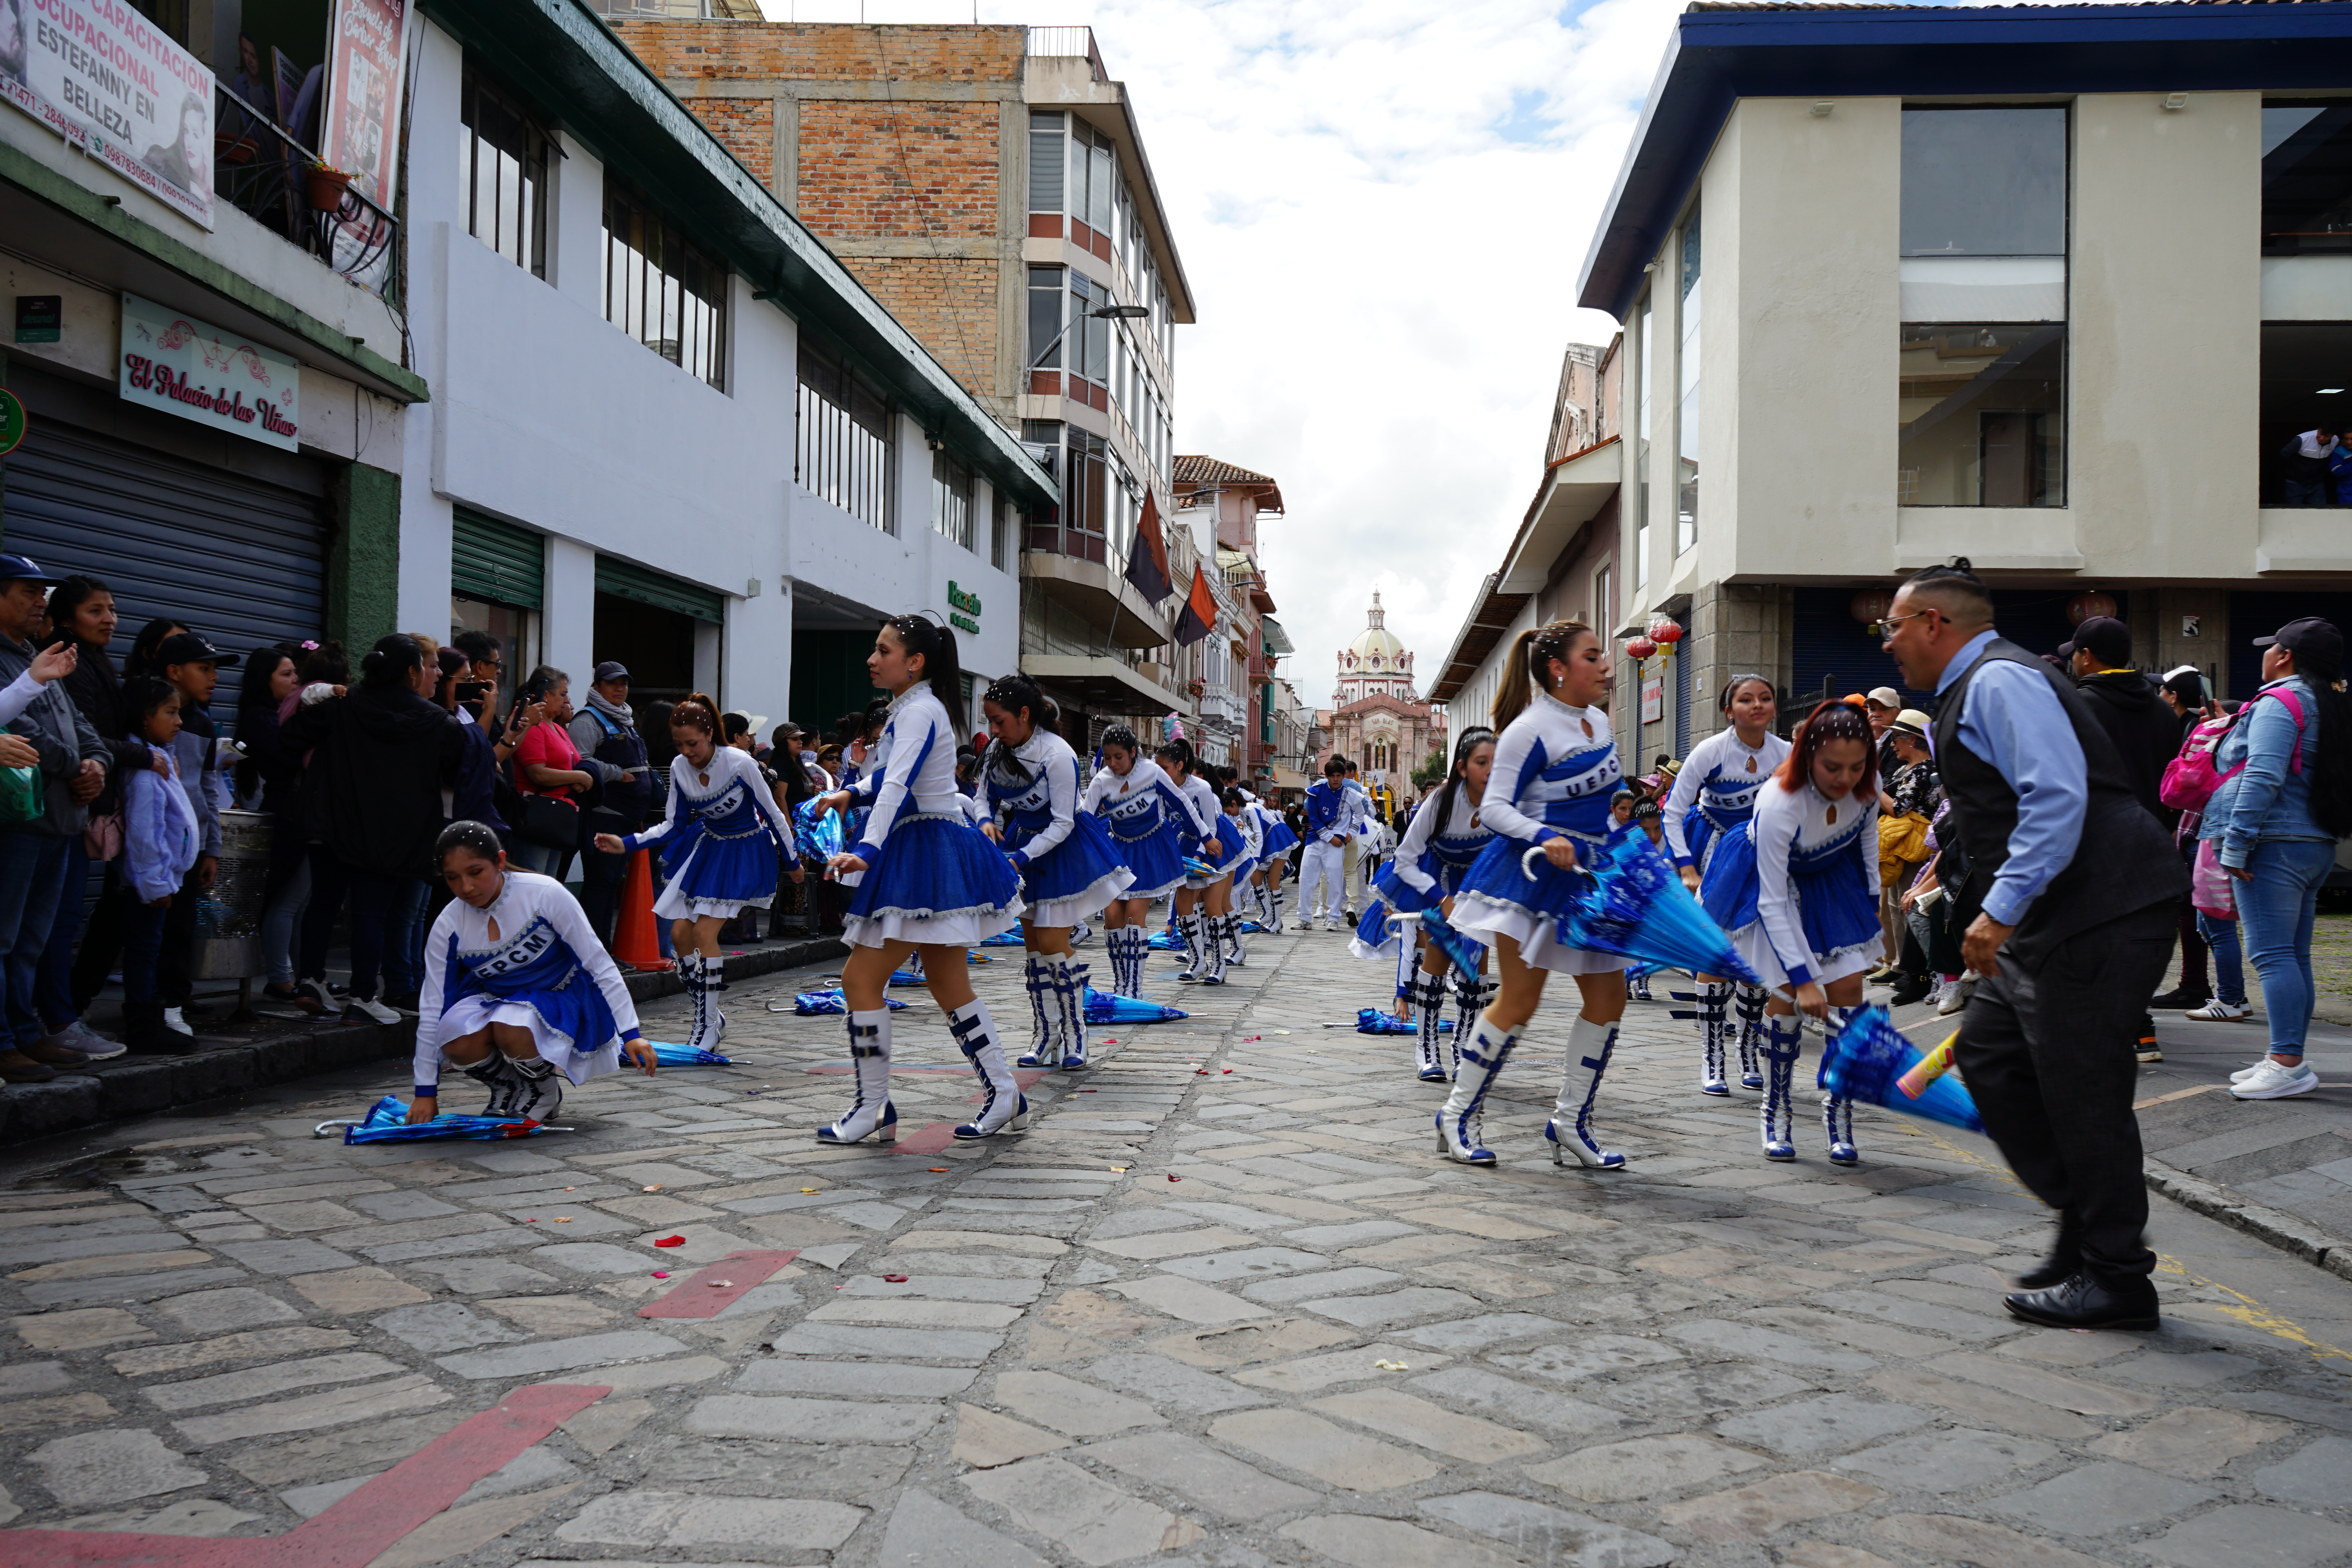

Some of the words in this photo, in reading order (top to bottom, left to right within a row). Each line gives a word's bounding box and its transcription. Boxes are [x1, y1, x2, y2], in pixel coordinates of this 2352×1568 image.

[343, 10, 375, 49] Barber
[375, 40, 398, 79] Shop
[352, 0, 383, 36] Escuela
[383, 18, 393, 43] de
[37, 18, 131, 105] ESTEFANNY
[136, 91, 154, 124] EN
[91, 0, 208, 100] CAPACITACIÓN
[64, 76, 132, 145] BELLEZA
[104, 144, 156, 187] 0987830684
[126, 354, 154, 390] El
[156, 365, 215, 409] Palacio
[216, 388, 233, 416] de
[234, 391, 256, 423] las
[257, 398, 297, 437] Uñas
[1566, 755, 1620, 797] UEPC
[704, 797, 737, 817] PCM
[473, 934, 548, 978] EPCM
